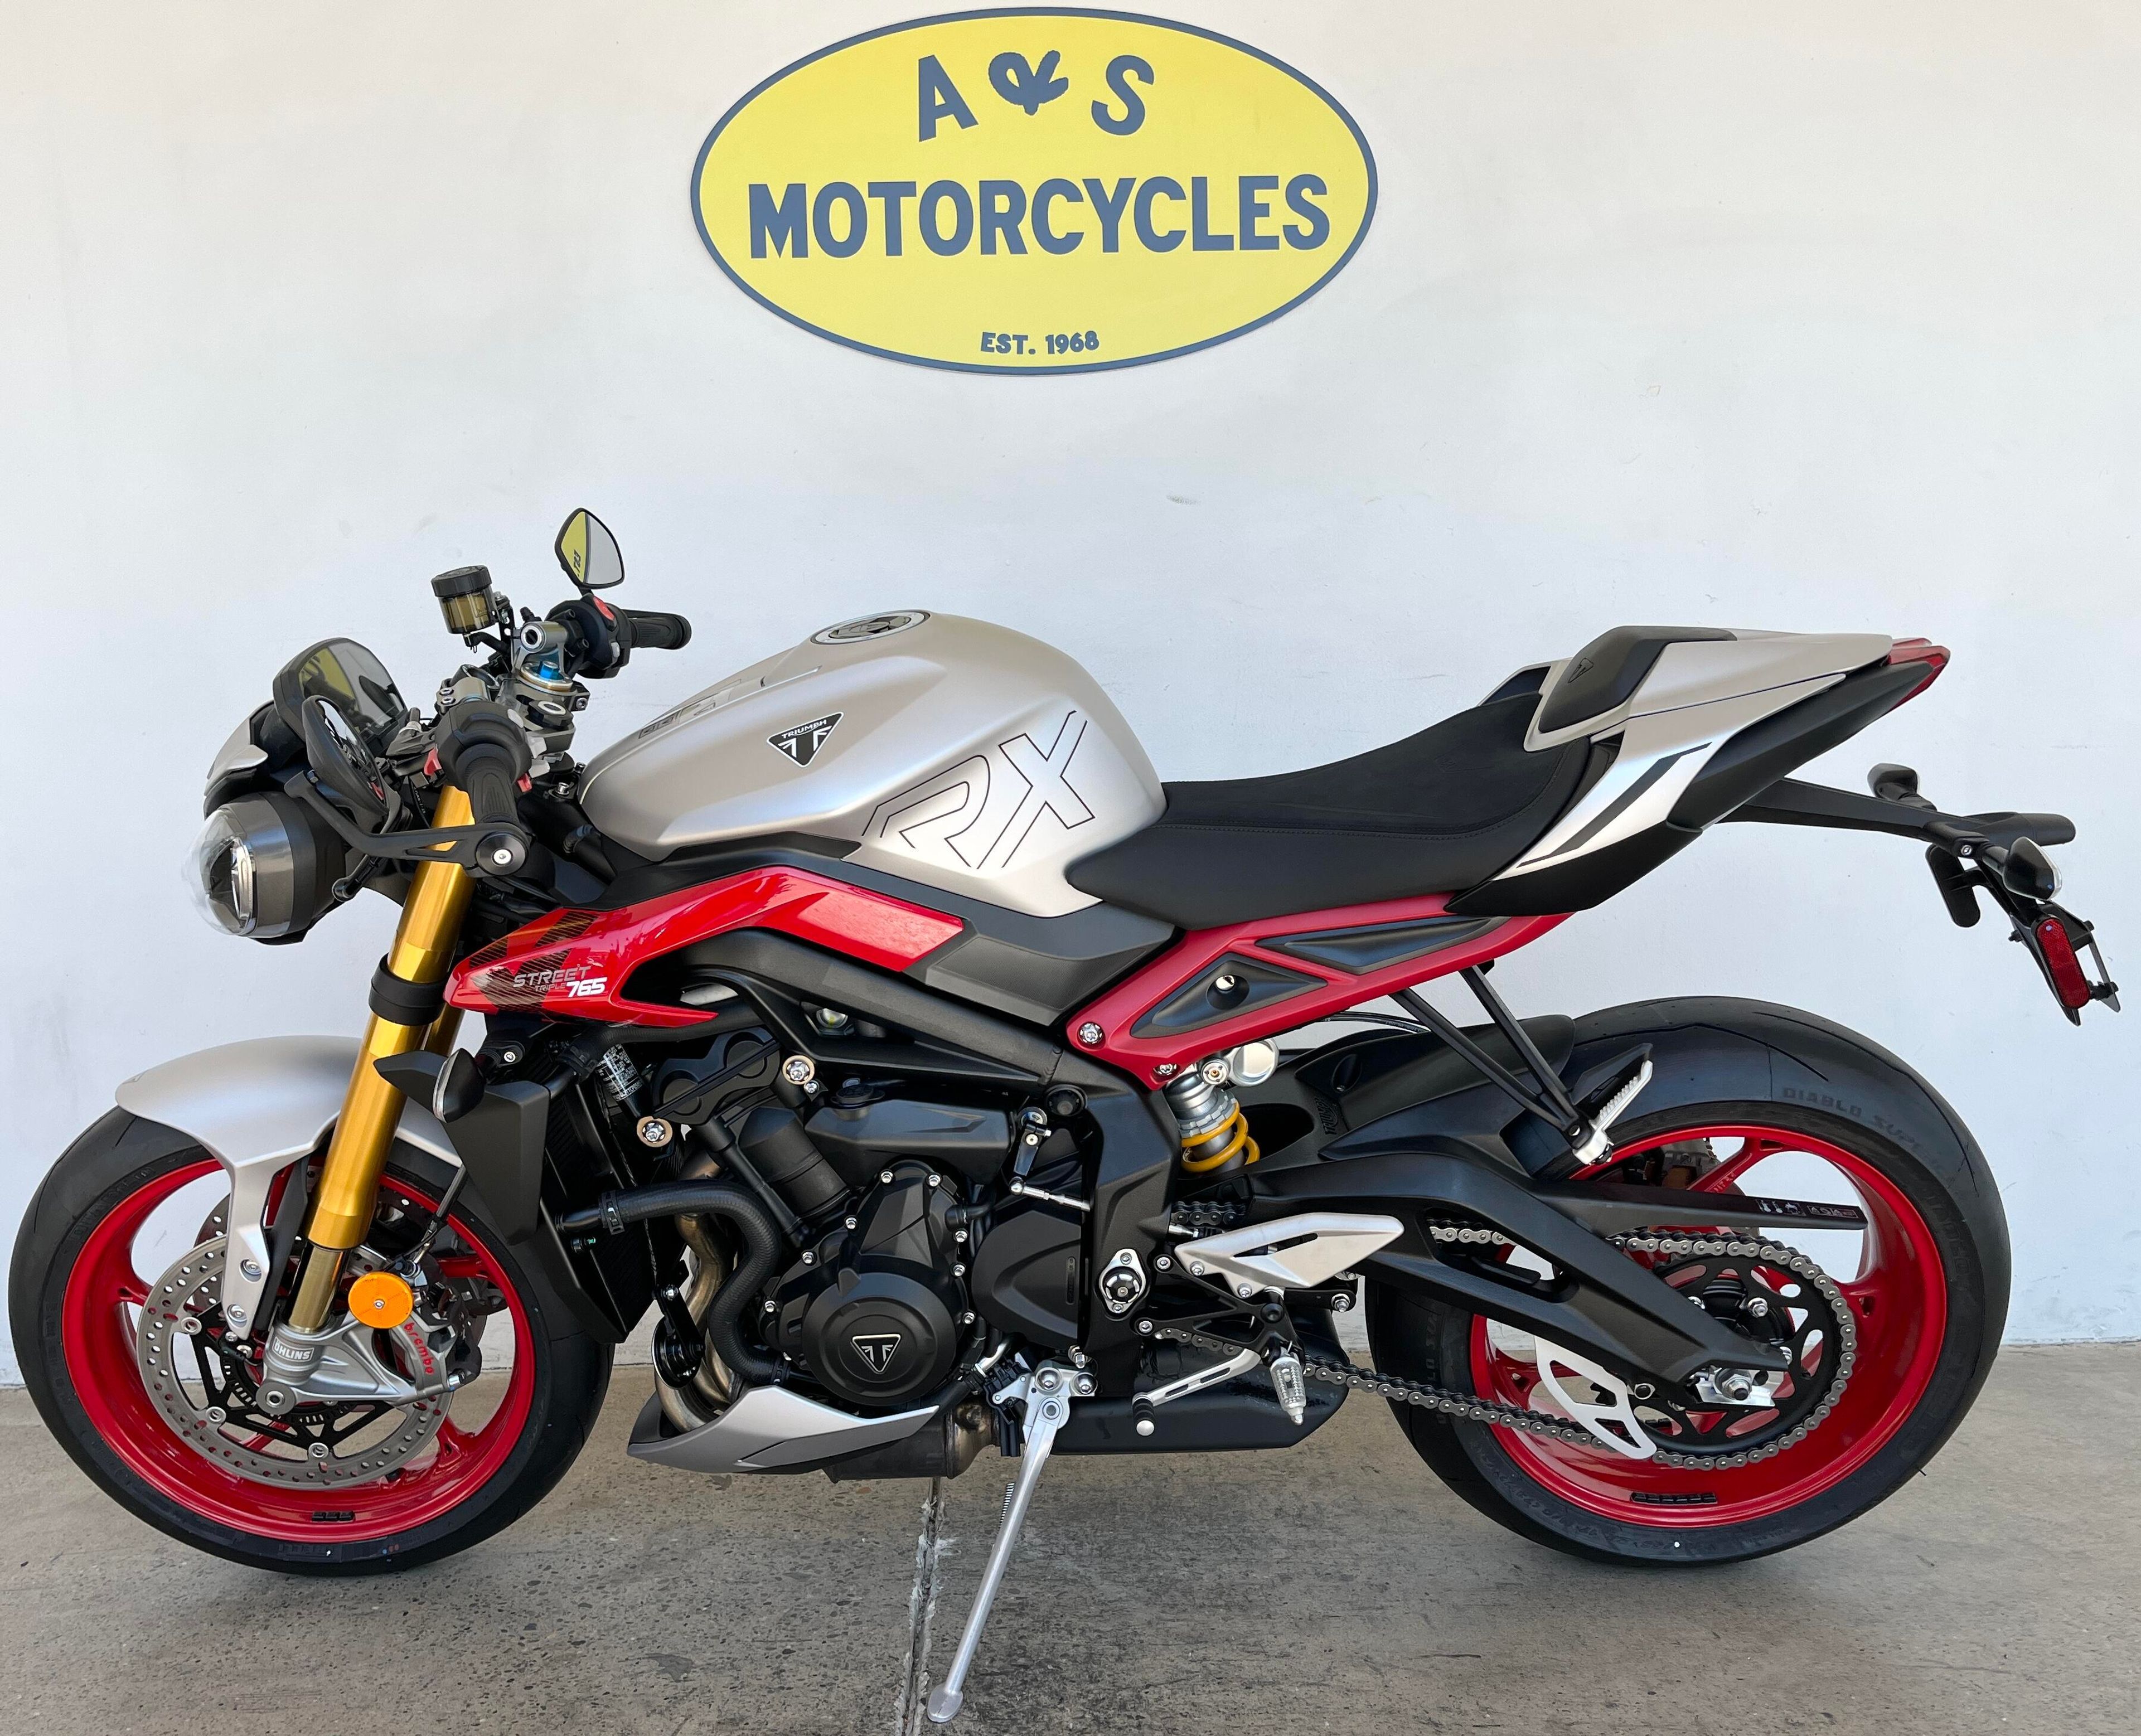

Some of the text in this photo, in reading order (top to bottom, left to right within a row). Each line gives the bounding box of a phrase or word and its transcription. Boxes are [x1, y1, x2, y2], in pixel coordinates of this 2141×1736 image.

[919, 55, 978, 142] A
[1091, 55, 1154, 135] S
[749, 174, 1330, 259] MOTORCYCLES
[981, 331, 1099, 355] EST. 1968
[781, 719, 827, 739] TRIUMPH
[862, 710, 1094, 870] RX
[512, 966, 592, 988] STREET
[535, 983, 566, 992] TRIPLE
[566, 977, 608, 997] 765
[1785, 1088, 1862, 1116] DIABLO
[404, 1322, 434, 1374] brembo
